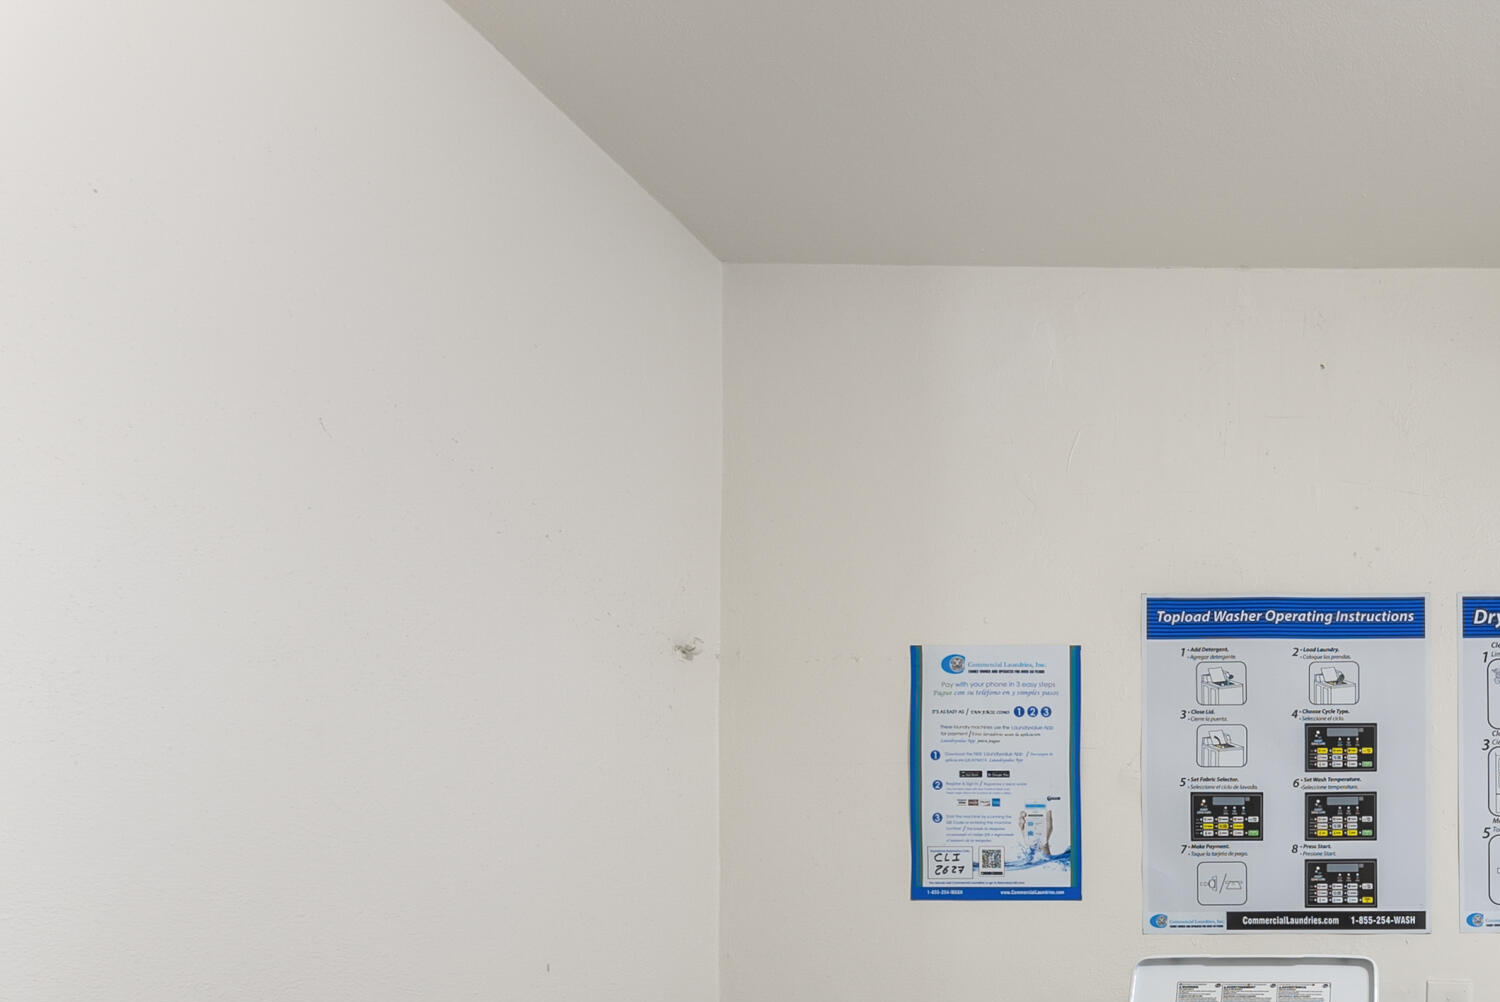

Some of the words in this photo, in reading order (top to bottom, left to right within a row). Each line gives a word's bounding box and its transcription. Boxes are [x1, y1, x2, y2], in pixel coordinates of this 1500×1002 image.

[1157, 610, 1210, 625] Topload
[1214, 610, 1264, 622] Washer
[1265, 610, 1333, 625] Operating
[1336, 610, 1414, 623] Instructions
[1181, 648, 1185, 656] 1
[1292, 648, 1299, 656] 2
[1483, 652, 1488, 663] 1
[1180, 710, 1186, 719] 3
[1292, 710, 1298, 718] 4
[1482, 739, 1490, 750] 3
[1180, 778, 1186, 786] 5
[1293, 779, 1299, 788] 6
[1482, 827, 1491, 838] 5
[1181, 845, 1187, 854] 7
[1292, 844, 1298, 853] 8
[934, 853, 961, 862] CLI
[935, 865, 965, 875] 2627
[1242, 916, 1339, 925] CommercialLaundries.com
[1351, 916, 1416, 925] 1-855-254-WASH
